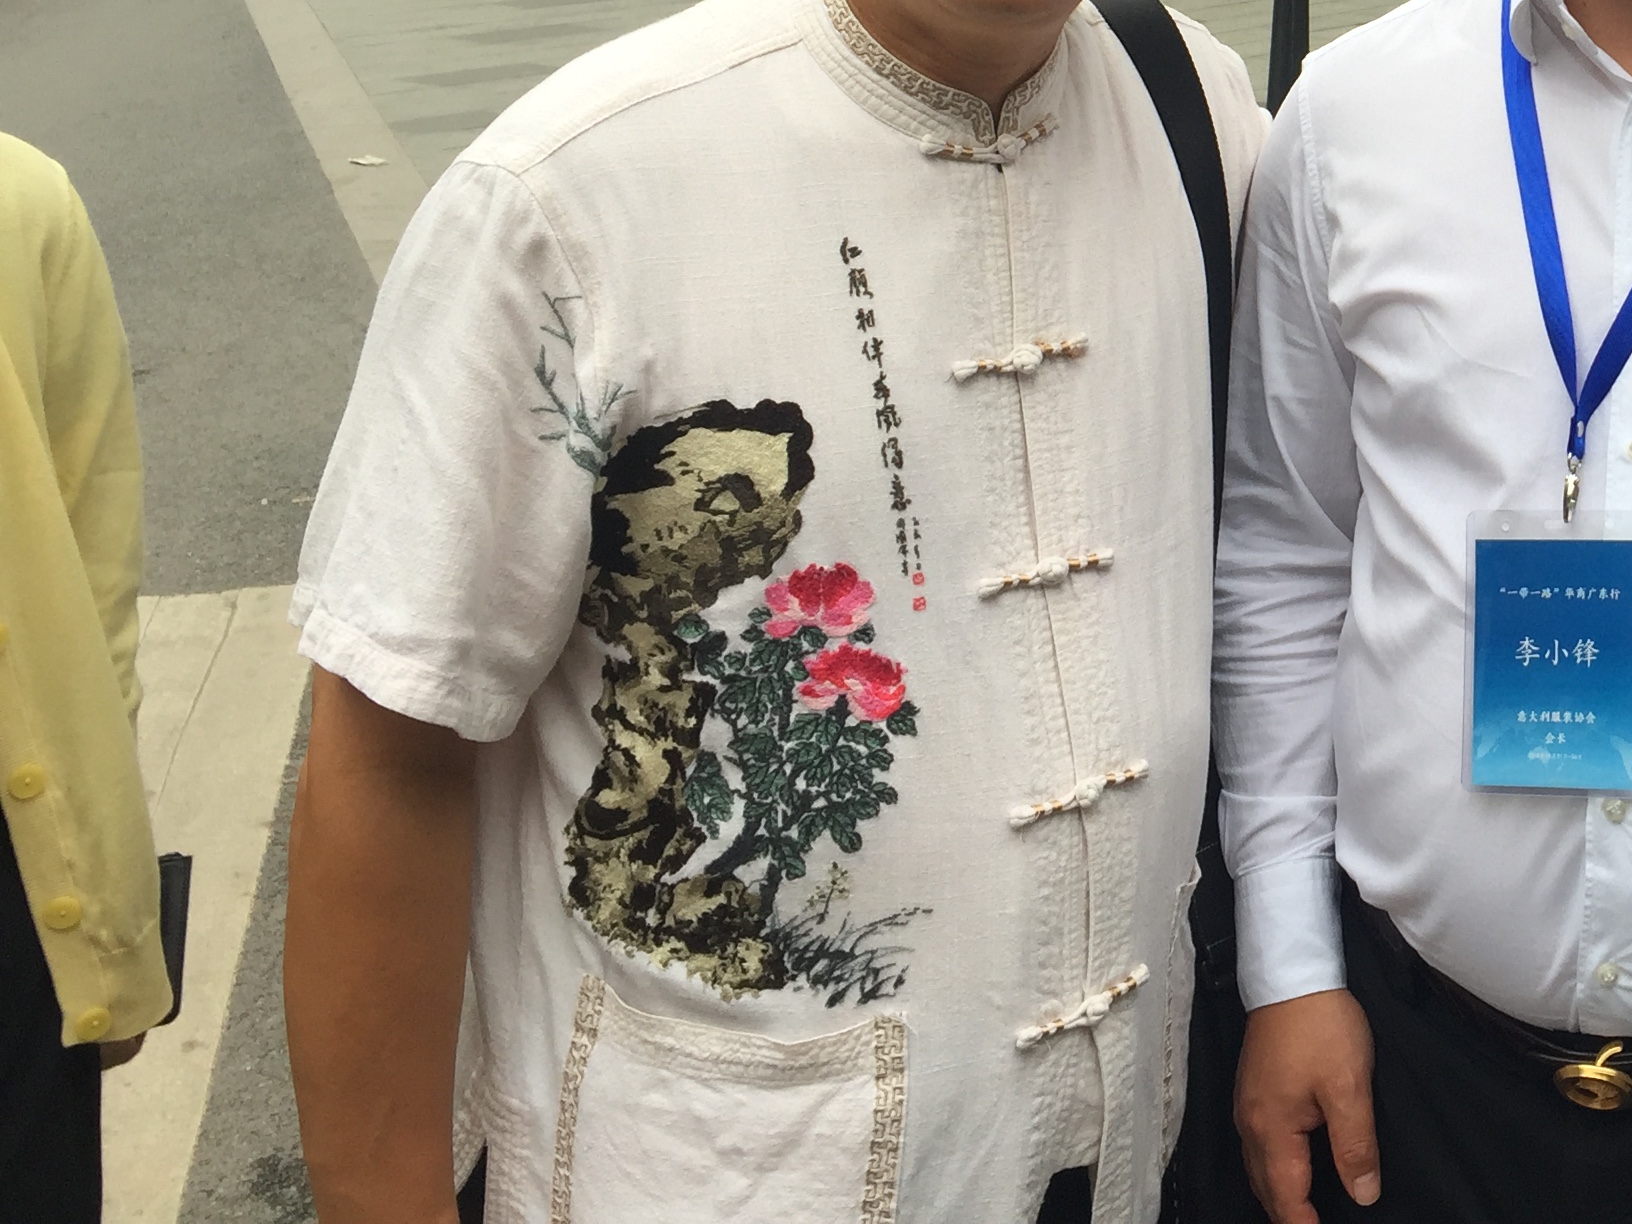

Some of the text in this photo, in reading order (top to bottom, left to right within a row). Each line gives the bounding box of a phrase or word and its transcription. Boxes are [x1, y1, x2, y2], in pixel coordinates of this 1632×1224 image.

[1515, 636, 1600, 668] 李小锋
[1517, 710, 1597, 724] 意大利服装协会
[1544, 731, 1567, 744] 会长
